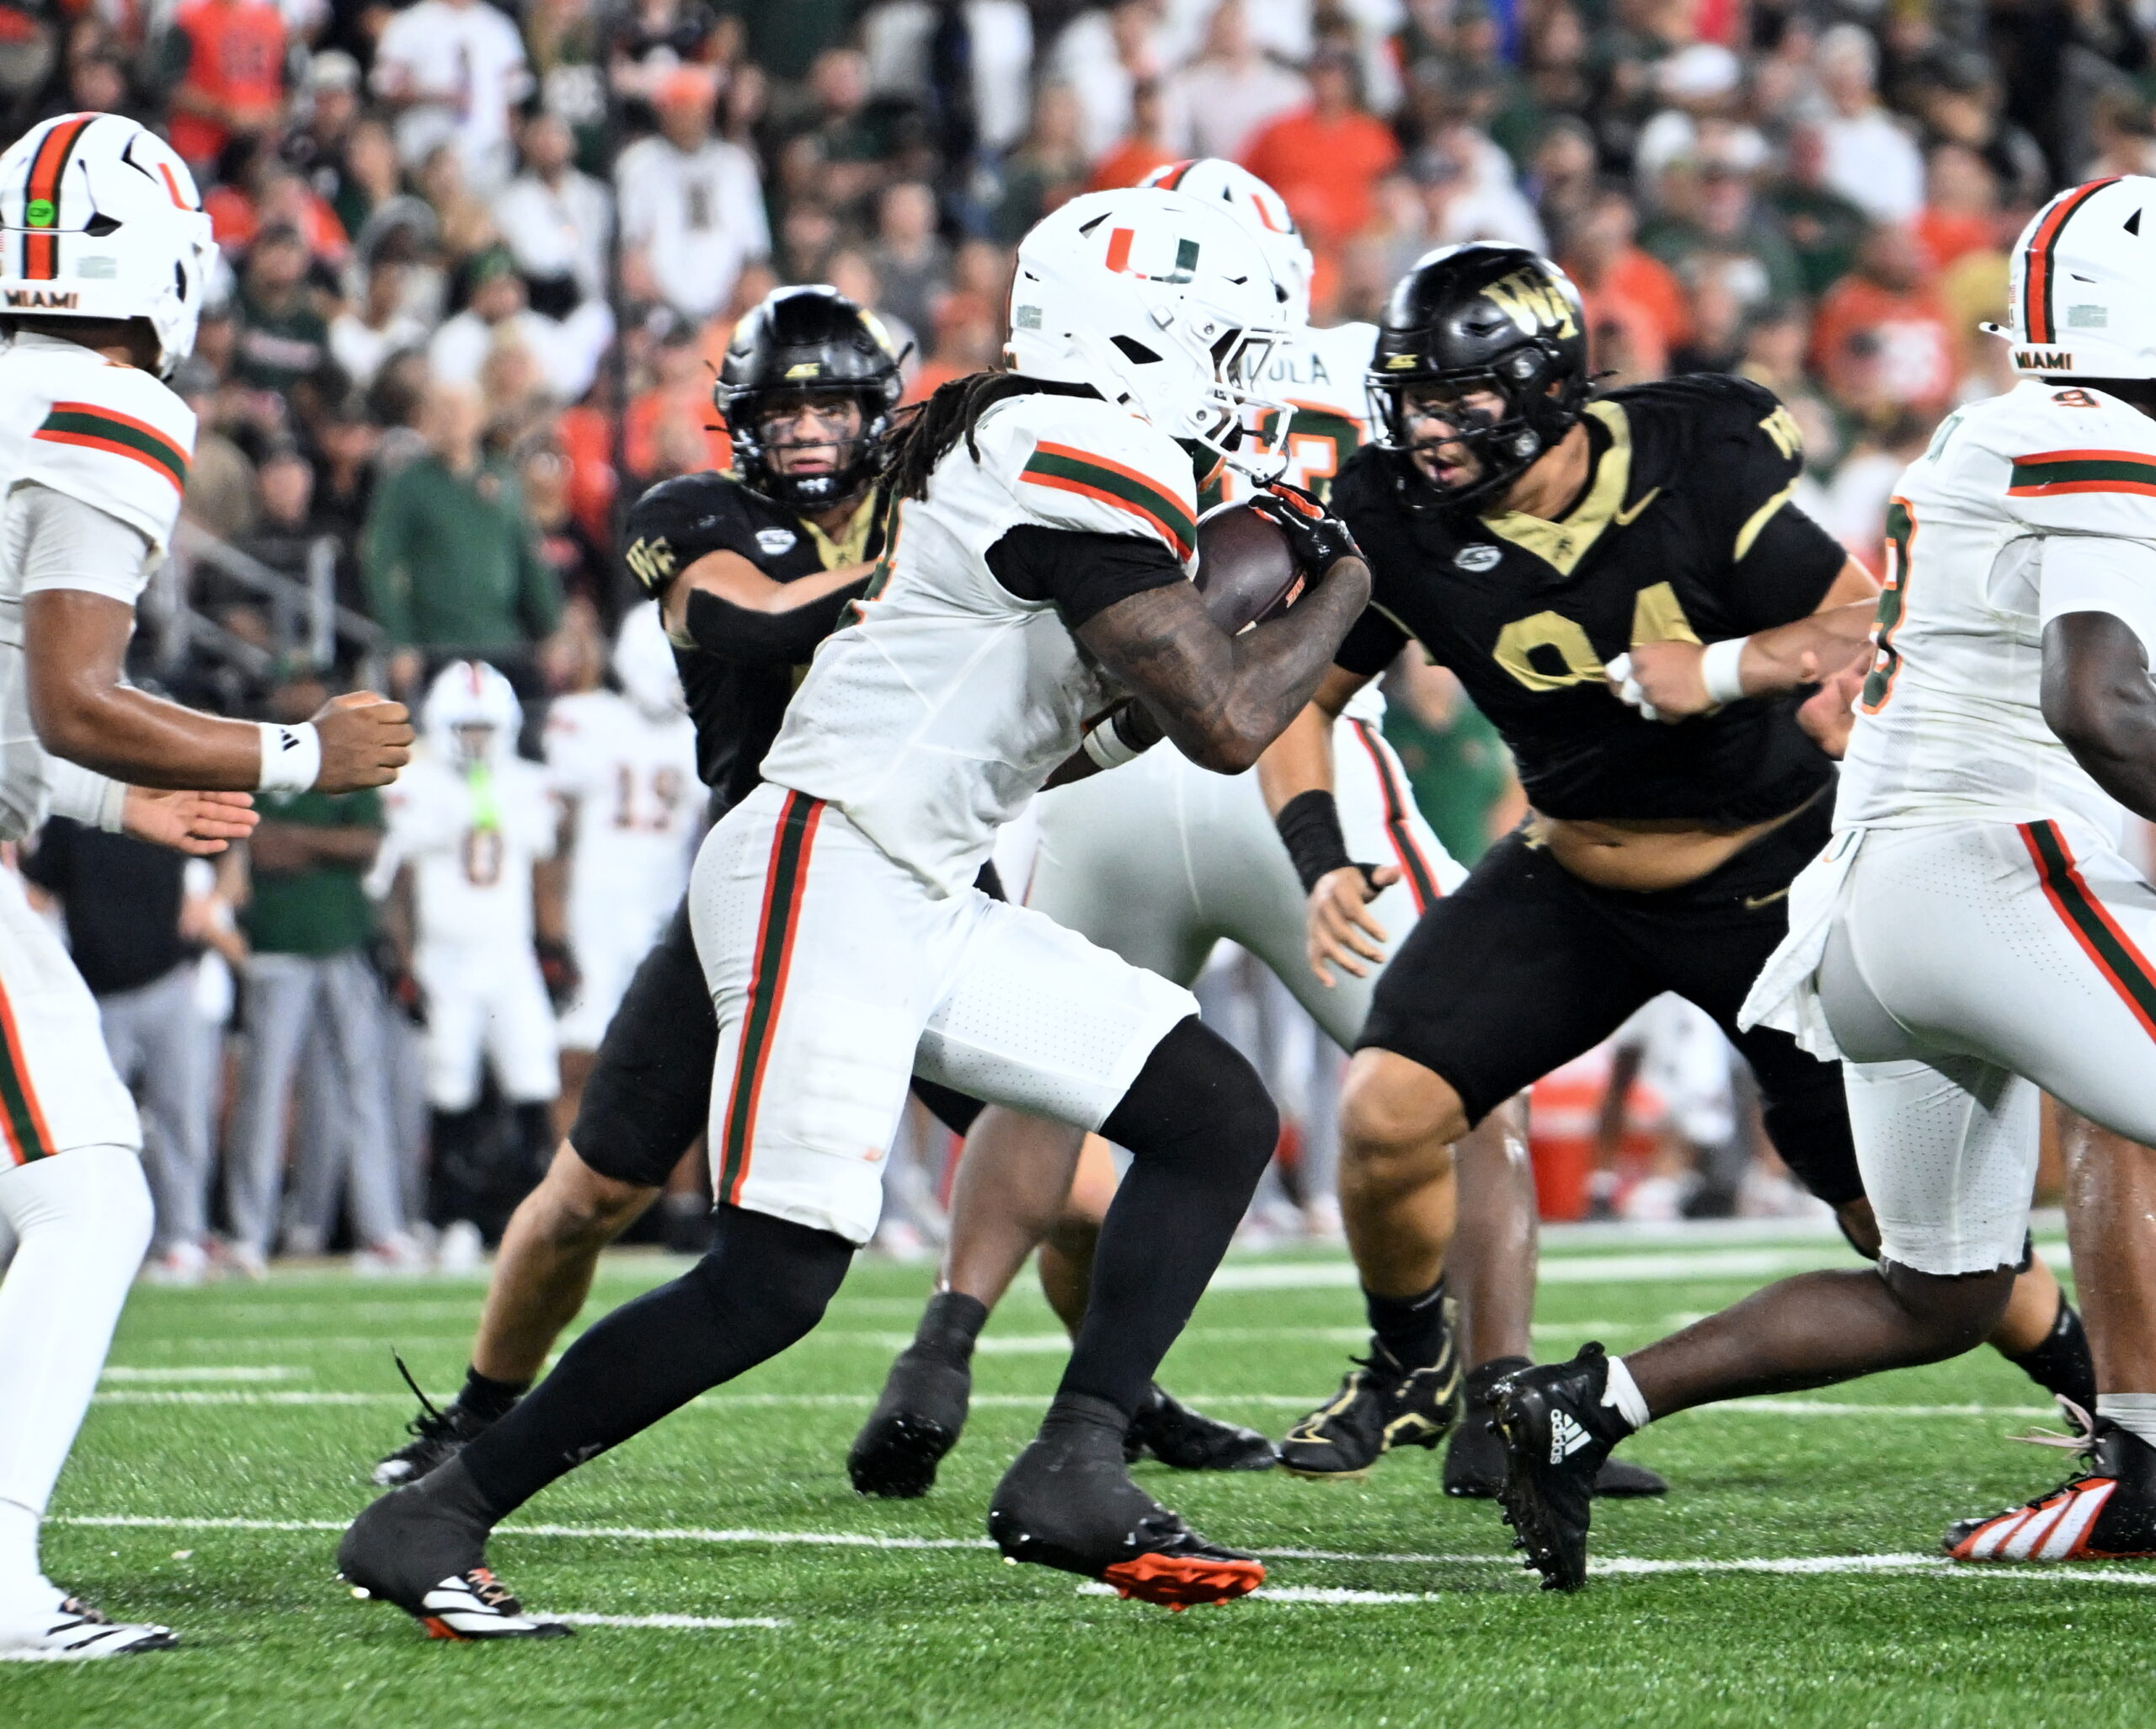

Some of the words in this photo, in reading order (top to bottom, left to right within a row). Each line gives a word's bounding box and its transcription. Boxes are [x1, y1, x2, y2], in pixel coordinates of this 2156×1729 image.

[3, 289, 78, 309] MIAMI
[2015, 350, 2073, 371] MIAMI
[1550, 1408, 1566, 1465] adidas
